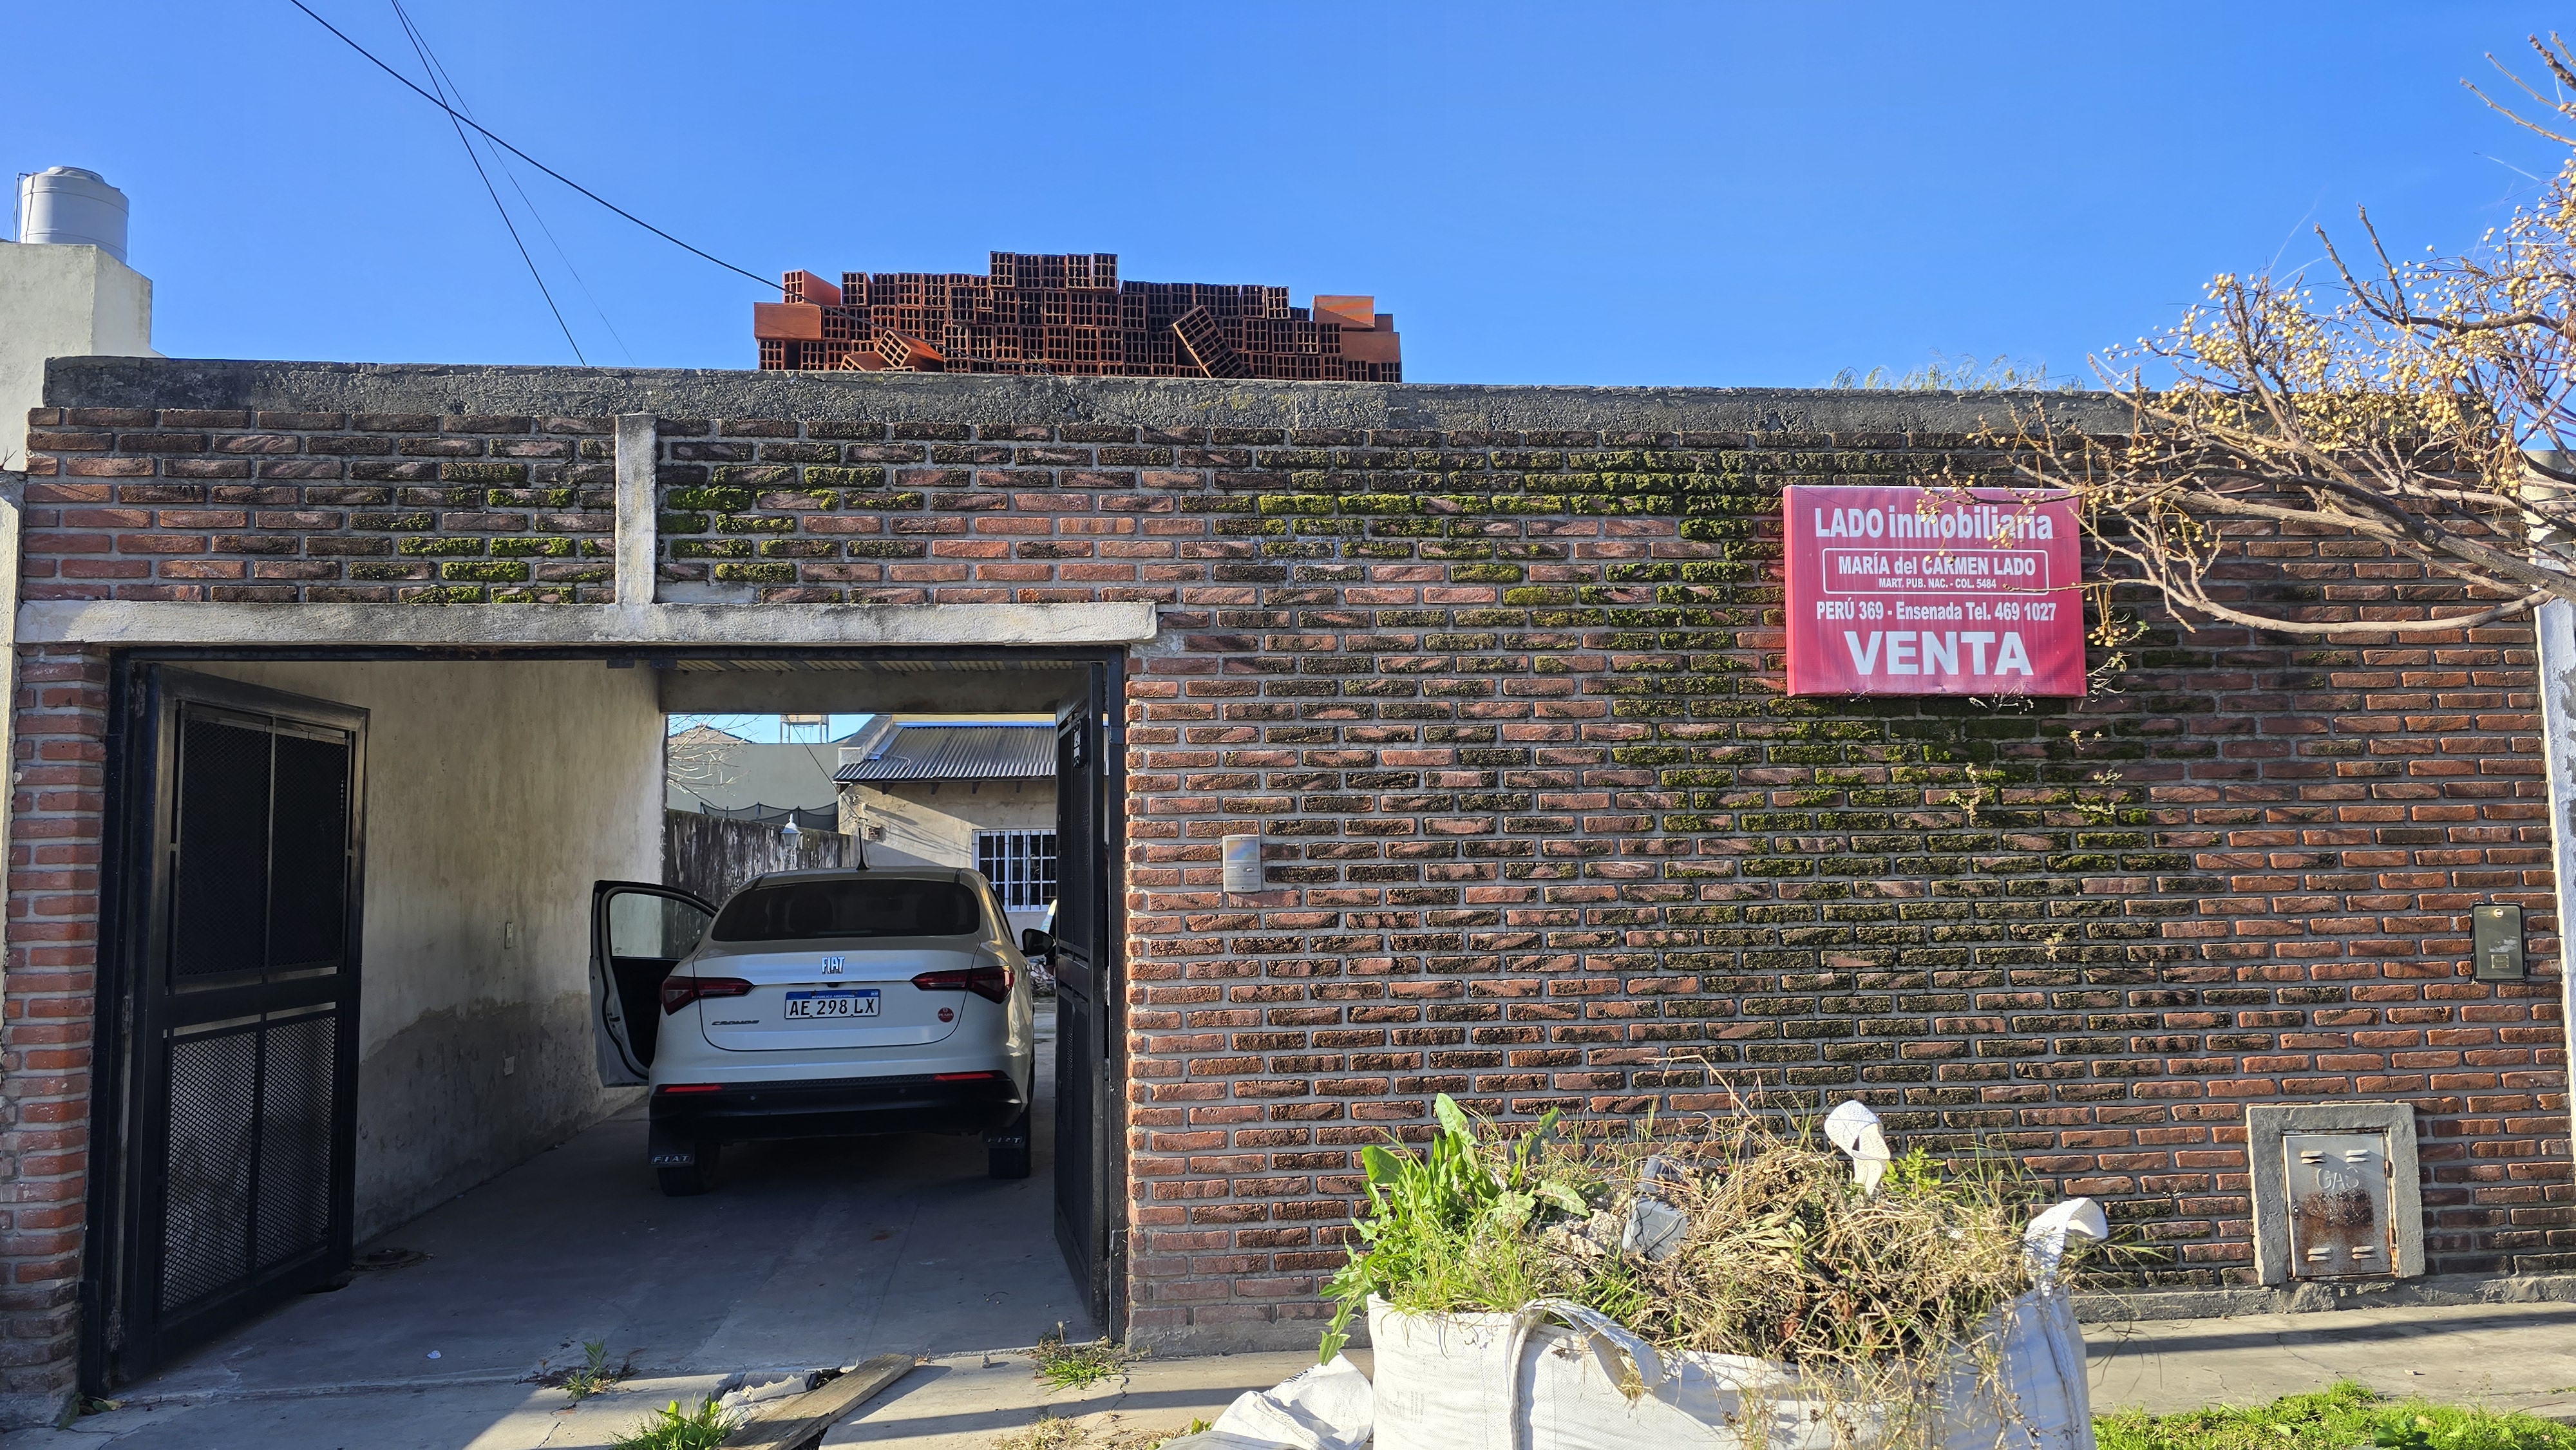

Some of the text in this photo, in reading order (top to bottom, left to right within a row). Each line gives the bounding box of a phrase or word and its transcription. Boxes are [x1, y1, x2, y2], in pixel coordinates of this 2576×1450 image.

[1815, 505, 2054, 540] LADO inmobiliaria
[1838, 552, 2036, 576] MARÍA del CARMEN LADO
[1879, 578, 1904, 588] MART.
[1906, 578, 1926, 588] PUB.
[1928, 578, 1948, 588] NAC.
[1955, 578, 1975, 588] COL.
[1976, 578, 1996, 588] 5484
[1816, 597, 1855, 620] PERÚ
[1859, 601, 1884, 620] 369
[1896, 601, 1962, 620] Ensenada
[1965, 601, 1991, 620] Tel.
[1994, 602, 2020, 621] 469
[2024, 602, 2057, 621] 1027
[1844, 631, 2034, 675] VENTA
[822, 956, 845, 974] FIAT
[790, 999, 875, 1015] AE 298 LX
[2316, 1166, 2359, 1190] GAS
